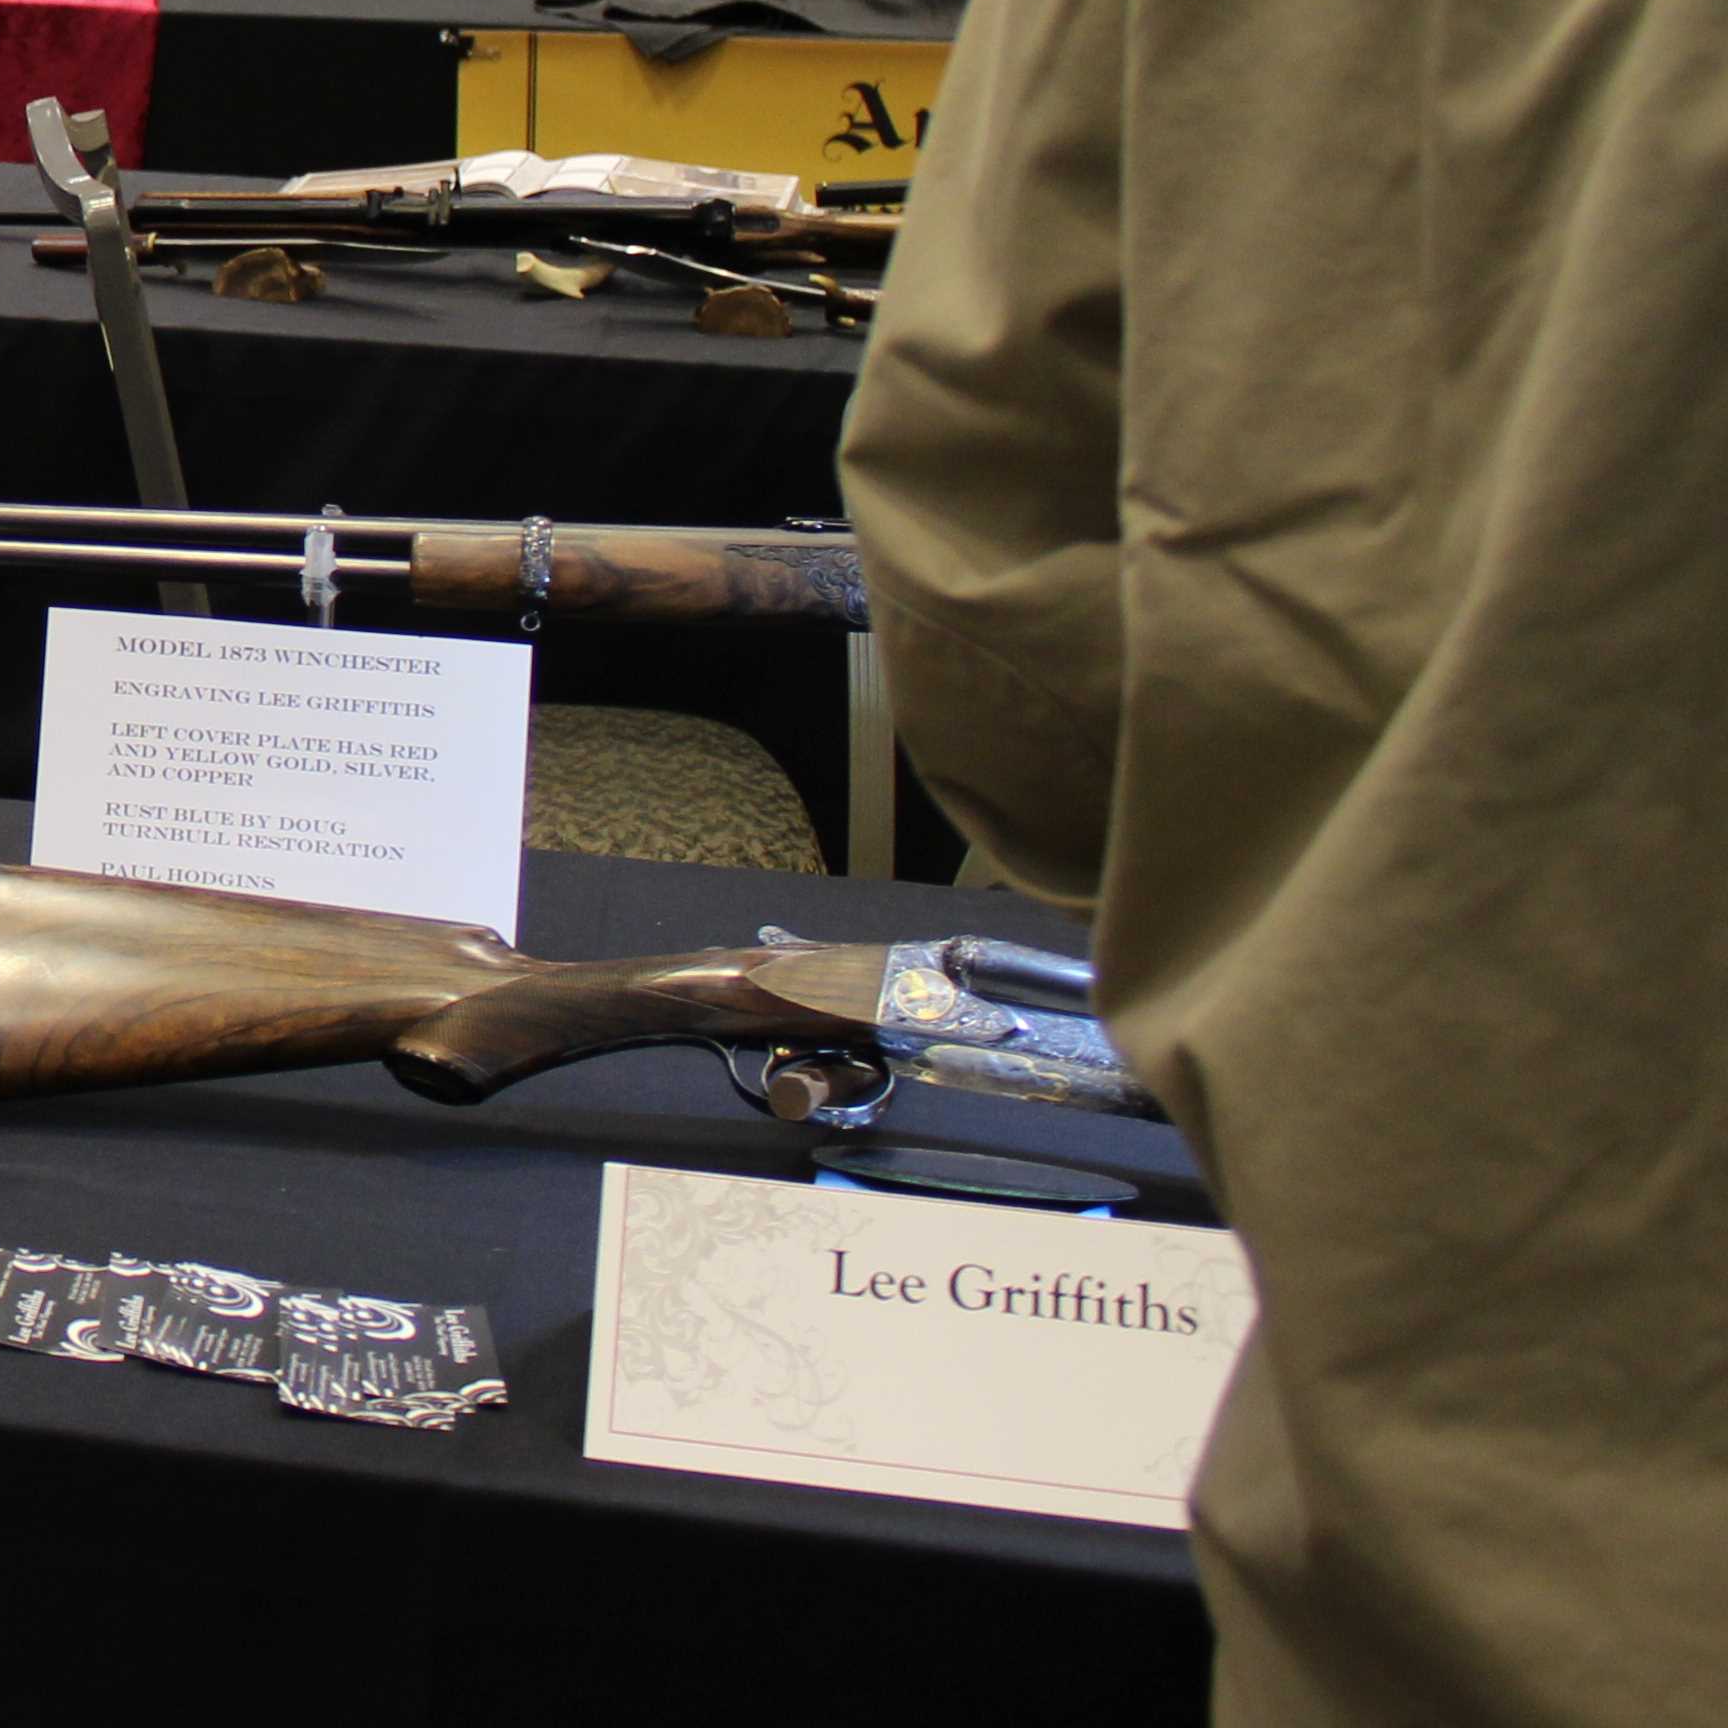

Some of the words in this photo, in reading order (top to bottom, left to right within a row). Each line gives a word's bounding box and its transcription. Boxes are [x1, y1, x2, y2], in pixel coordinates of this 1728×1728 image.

[116, 635, 211, 660] MODEL
[219, 645, 268, 663] 1873
[275, 649, 442, 676] WINCHESTER
[113, 680, 252, 705] ENGRAVING
[257, 691, 301, 710] LEE
[306, 695, 436, 719] GRIFFITHS
[108, 742, 158, 761] AND
[166, 747, 259, 768] YELLOW
[110, 722, 169, 740] LEFT
[174, 726, 252, 748] COVER
[257, 733, 332, 754] PLATE
[337, 739, 385, 758] HAS
[389, 744, 439, 762] RED
[106, 762, 156, 780] AND
[162, 765, 254, 788] COPPER
[104, 802, 169, 821] RUST
[173, 807, 235, 828] BLUE
[240, 813, 271, 829] BY
[279, 816, 347, 837] DOUG
[102, 822, 231, 848] TURNBULL
[237, 833, 405, 862] RESTORATION
[100, 861, 161, 882] PAUL
[167, 868, 276, 891] HODGINS
[829, 1248, 928, 1305] Lee
[948, 1263, 1200, 1336] Griffiths
